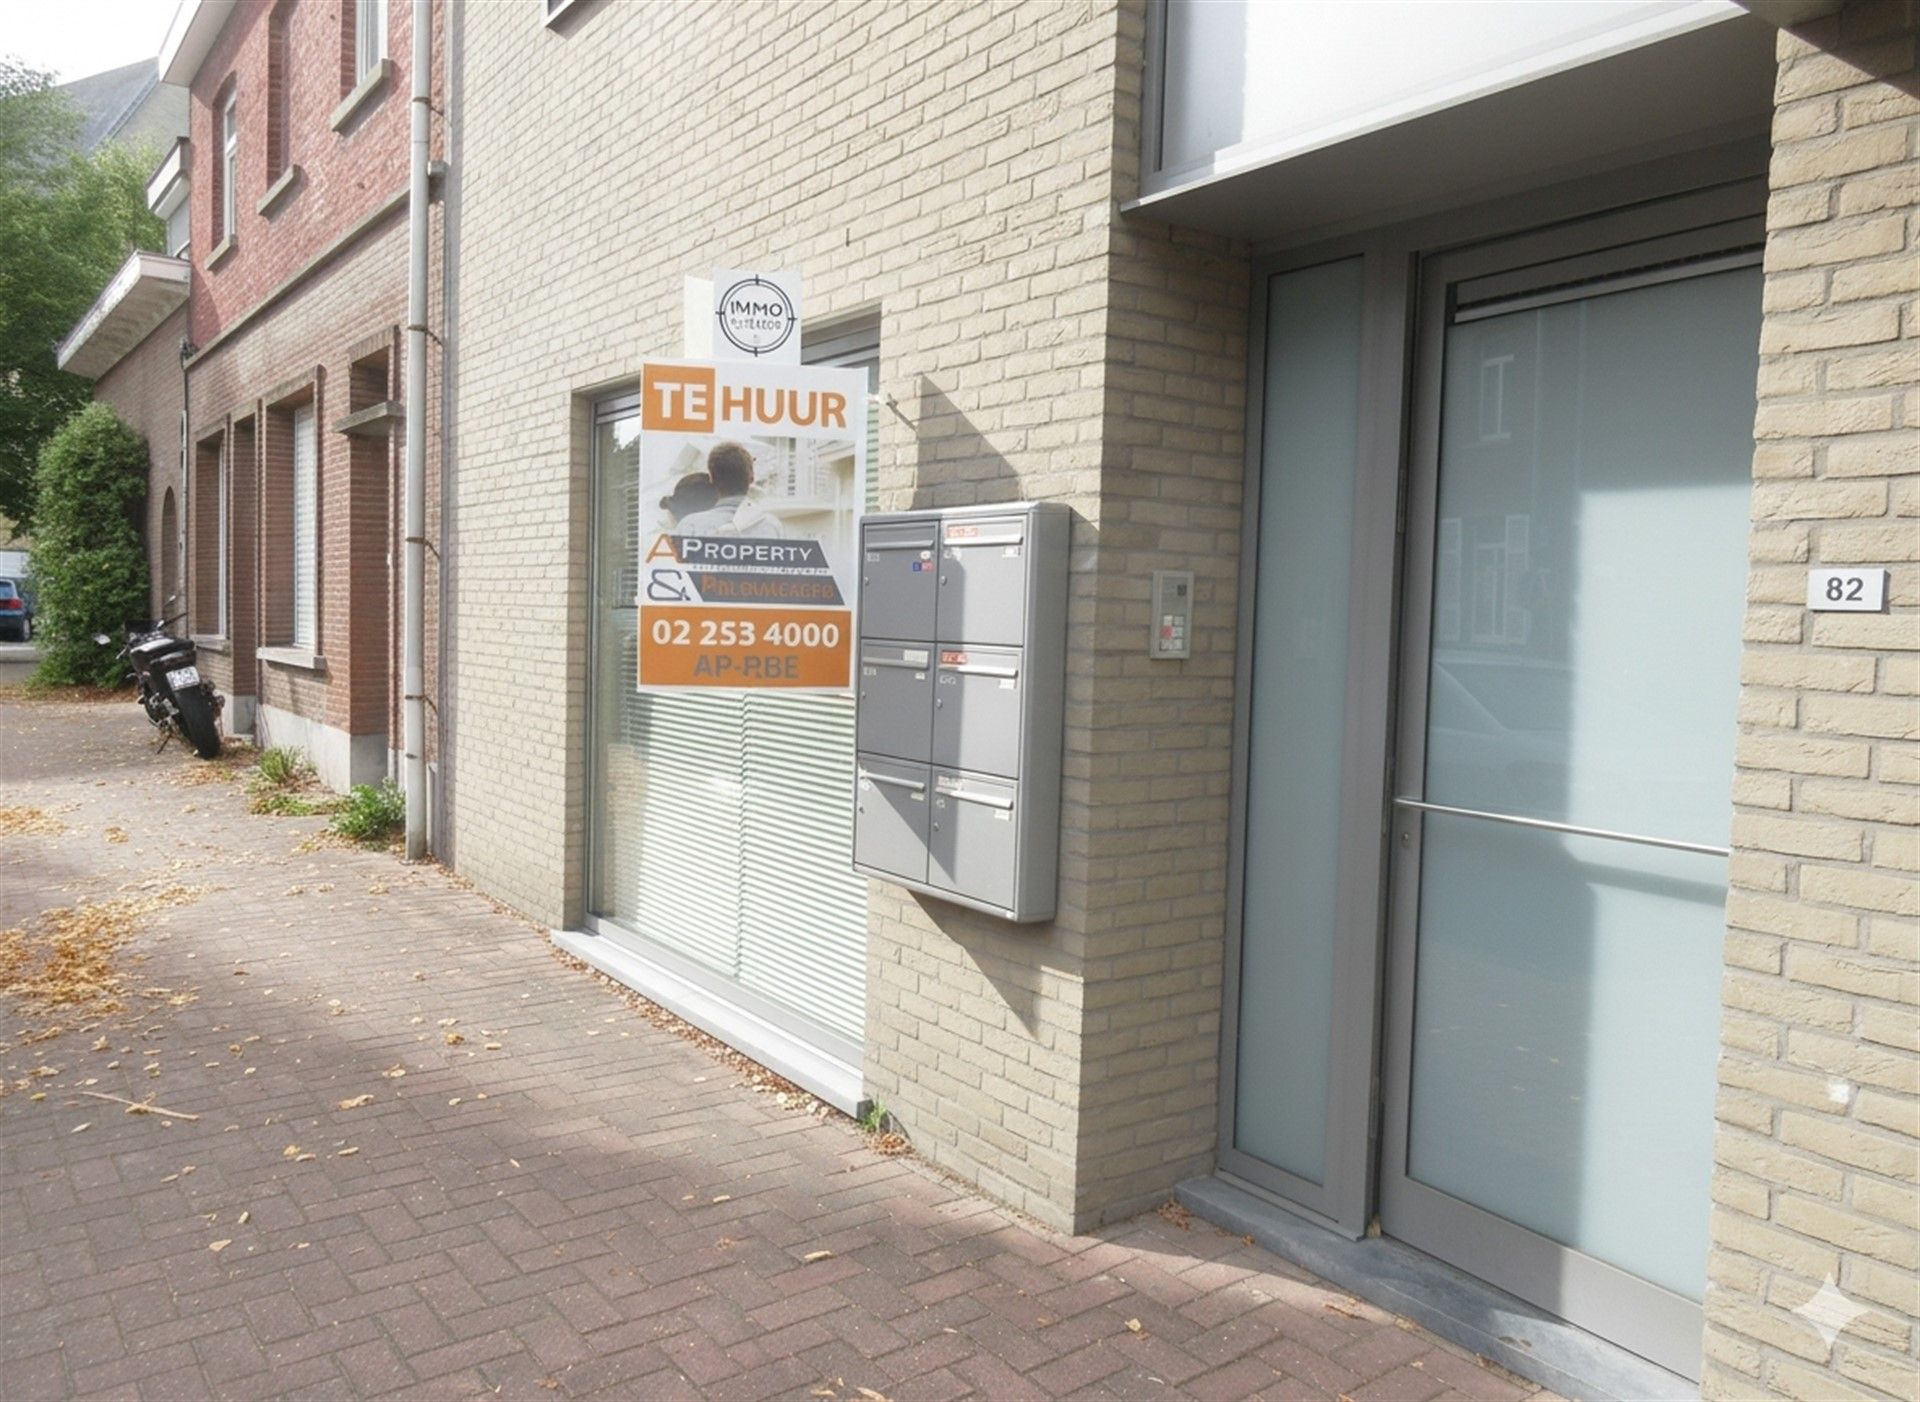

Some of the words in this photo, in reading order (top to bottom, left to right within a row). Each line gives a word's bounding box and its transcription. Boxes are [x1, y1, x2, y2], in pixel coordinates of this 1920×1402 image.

[730, 300, 783, 317] IMMO
[653, 382, 707, 421] TE
[722, 385, 847, 428] HUUR
[682, 538, 813, 562] PROPERTY
[1826, 576, 1864, 602] 82
[652, 619, 690, 645] 02
[700, 620, 756, 646] 253
[763, 621, 840, 648] 4000
